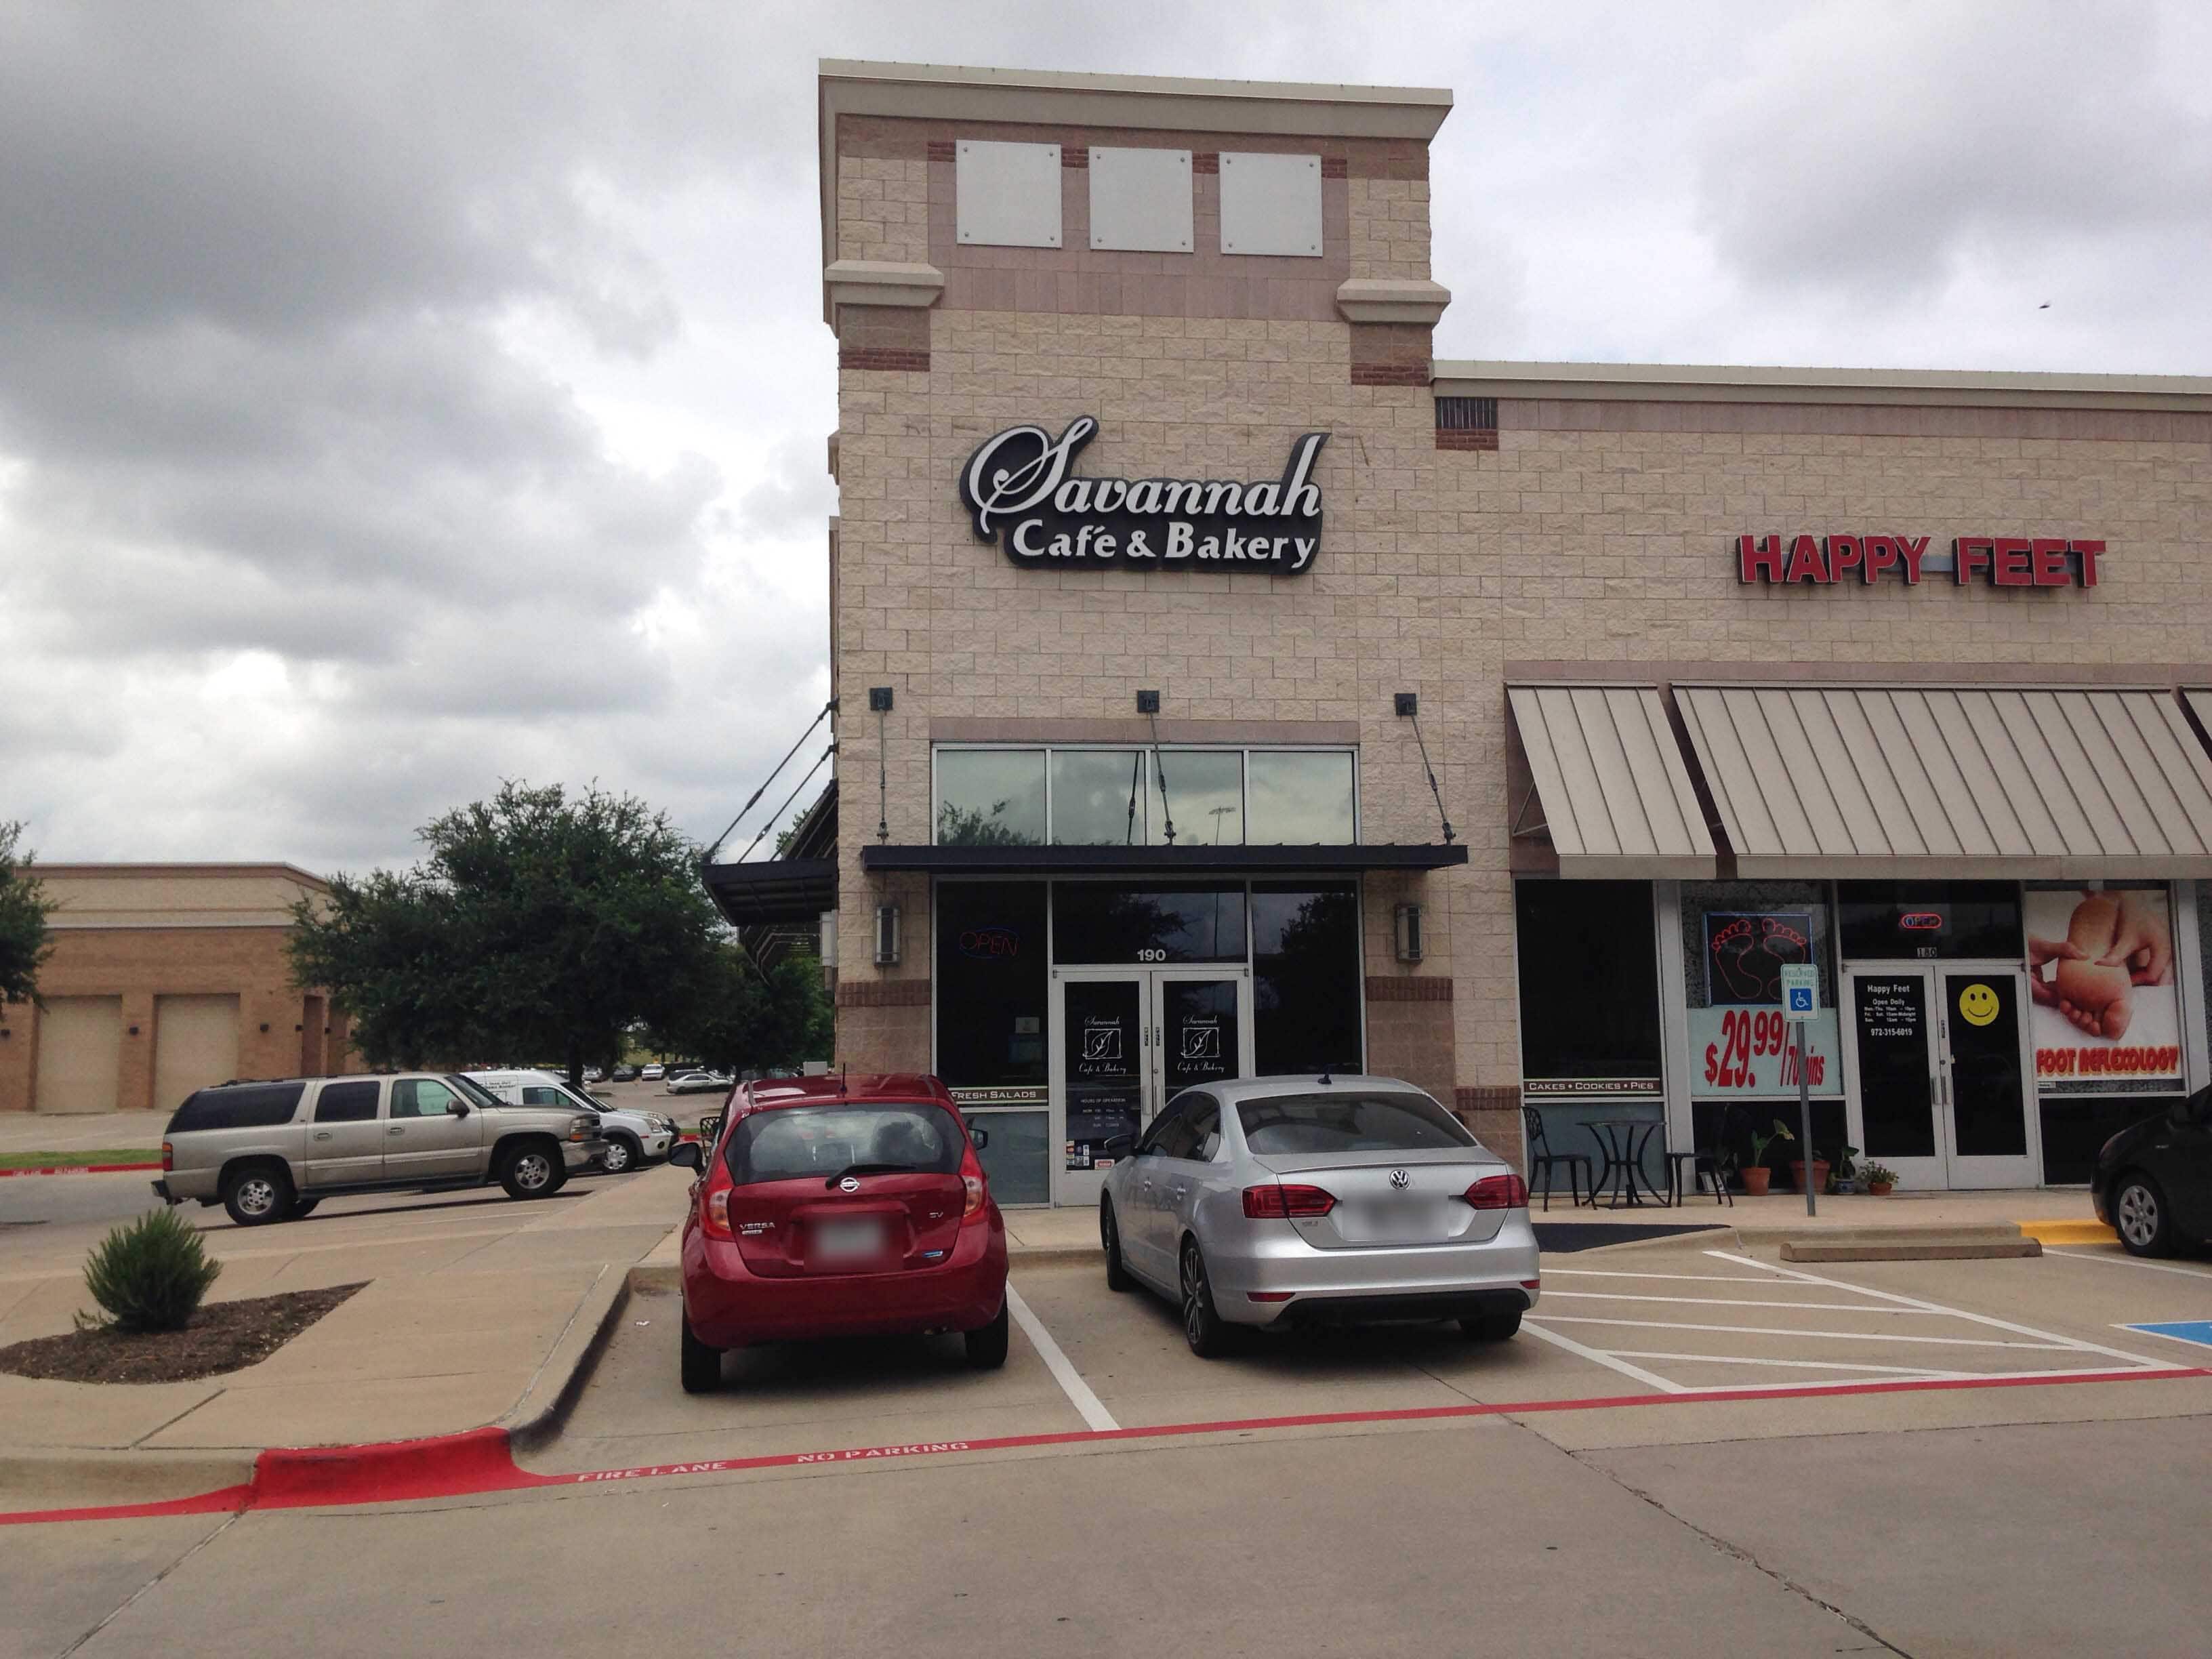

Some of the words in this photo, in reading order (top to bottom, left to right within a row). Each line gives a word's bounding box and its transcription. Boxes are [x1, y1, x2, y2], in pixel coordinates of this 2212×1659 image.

[969, 417, 1320, 533] Savannah
[1013, 519, 1116, 558] Café
[1126, 529, 1156, 558] &
[1164, 521, 1315, 569] Bakery
[1737, 534, 1931, 586] HAPPY
[1954, 537, 2106, 587] FEET
[960, 931, 1019, 957] OPEN
[1137, 949, 1166, 961] 190
[1867, 984, 1891, 994] Happy
[1893, 984, 1910, 992] Feet
[1870, 1028, 1912, 1036] 972-315-6019
[2036, 1048, 2076, 1076] FOOT
[2078, 1046, 2179, 1074] REFLEXOLOGY
[951, 1091, 987, 1099] FRESH
[739, 1222, 776, 1230] VERSA
[798, 1452, 837, 1462] NO
[846, 1442, 970, 1460] PARKING
[577, 1468, 641, 1482] FIRE
[651, 1461, 727, 1475] LANE
